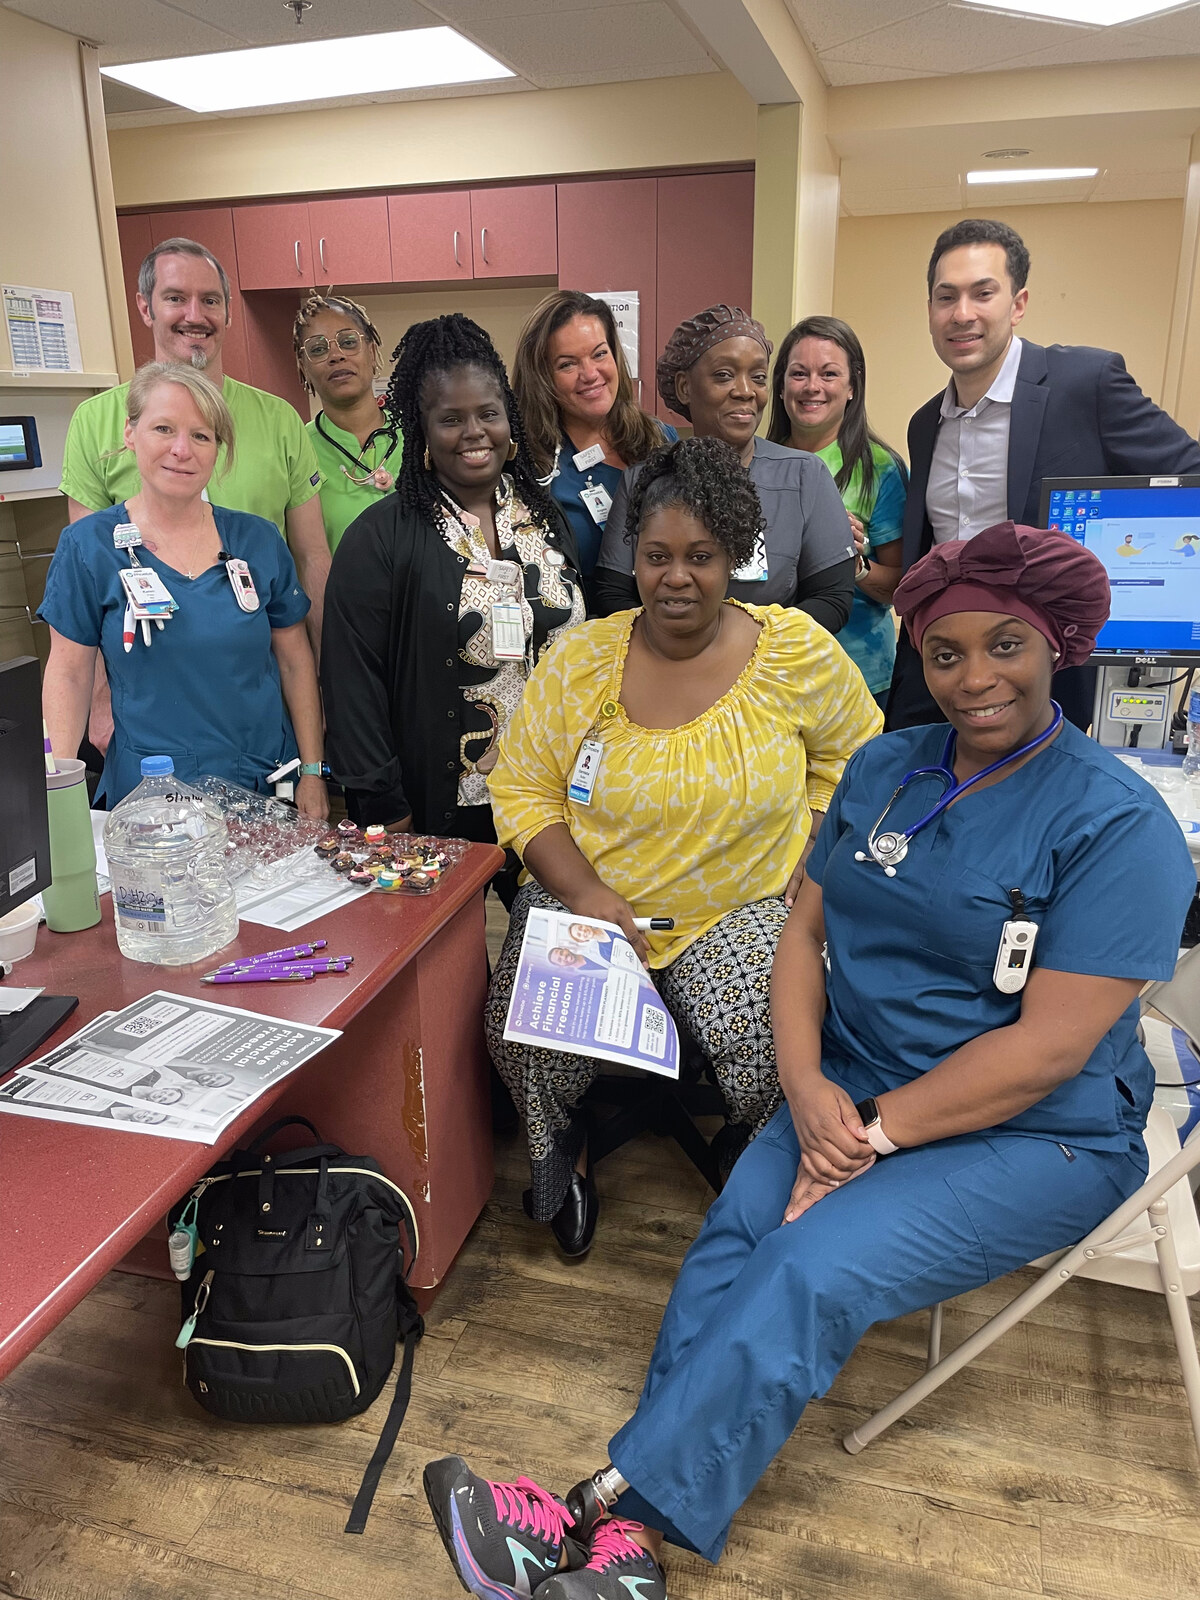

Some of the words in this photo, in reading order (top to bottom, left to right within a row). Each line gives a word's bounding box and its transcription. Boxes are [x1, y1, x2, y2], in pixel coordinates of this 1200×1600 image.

[529, 980, 547, 1029] Achieve
[542, 976, 561, 1032] Financial
[556, 982, 574, 1034] Freedom
[222, 1026, 278, 1062] Freedom
[234, 1029, 292, 1068] Financial
[256, 1032, 305, 1066] Achieve
